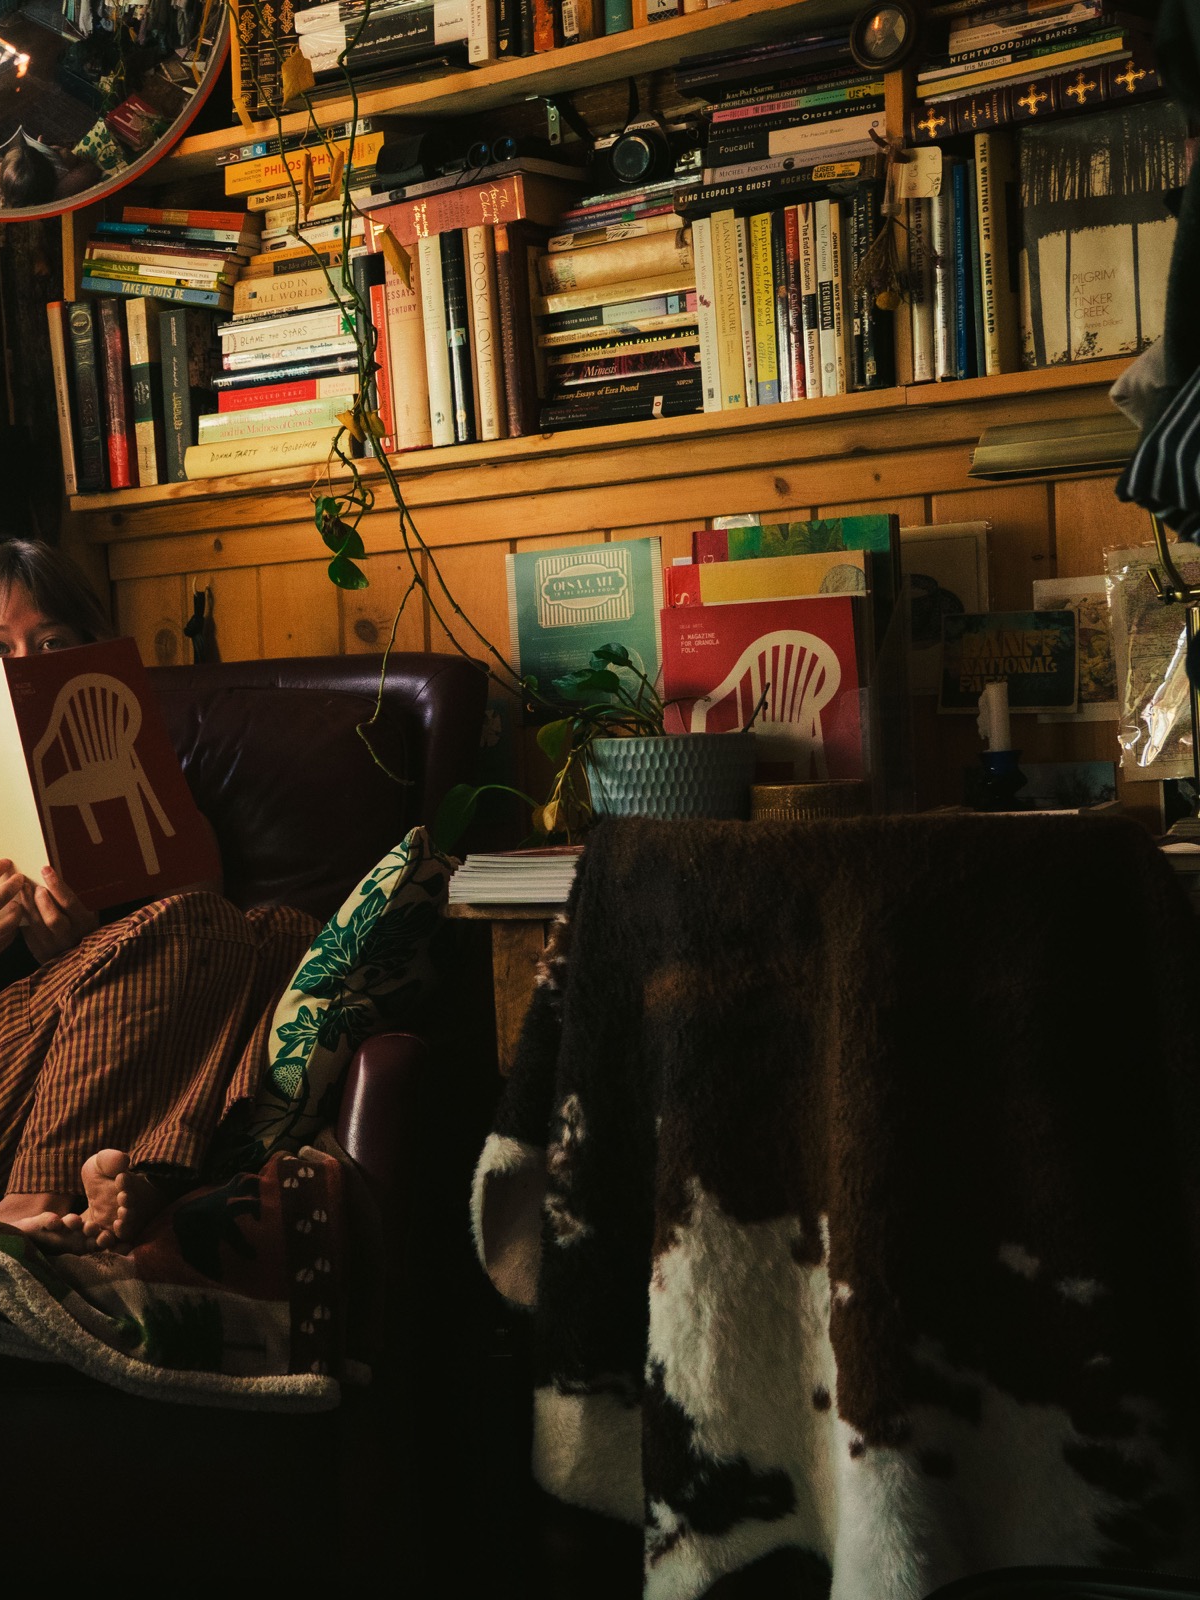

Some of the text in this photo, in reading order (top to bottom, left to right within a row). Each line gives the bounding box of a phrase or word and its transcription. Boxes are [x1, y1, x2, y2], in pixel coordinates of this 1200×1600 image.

[949, 25, 1078, 64] NIGHTWOOD DJUNA BARNES
[977, 56, 1007, 69] Murdoch
[721, 99, 756, 109] PROBLEMS
[766, 87, 808, 101] PHILOSOPHY
[817, 80, 848, 91] BERTRAND
[848, 75, 874, 86] RUSSELL
[627, 122, 657, 131] PENTAX
[712, 102, 877, 136] MICHEL ORDER THINGS
[718, 141, 755, 154] Foucault
[718, 161, 782, 178] MICHEL FOUCAULT
[255, 192, 288, 205] The Sun Also
[678, 180, 772, 203] KING LEOPOLD'S GHOST
[751, 229, 760, 261] Language
[979, 142, 995, 334] THE WRITING LIFE ANNIE DILLARD
[820, 223, 829, 272] Neil Postman
[424, 244, 435, 312] Alberto Manguel
[722, 221, 737, 332] LANGUAGES OF NATURE
[759, 217, 774, 326] Empires of the Word
[788, 226, 800, 333] Disappearance Childhood
[1072, 268, 1116, 285] PILGRIM
[121, 281, 153, 295] TAKE ME
[272, 278, 309, 291] GOD IN
[1073, 284, 1086, 296] AT
[256, 286, 323, 304] ALL WORLDS
[387, 287, 416, 301] ESSAYS
[802, 223, 817, 374] The End Education Neil Postman
[1073, 292, 1113, 308] TINKER
[739, 257, 745, 269] BY
[744, 330, 752, 369] DILLARD
[822, 280, 833, 331] TECHNOPOLY
[835, 302, 841, 312] OF
[1073, 304, 1110, 320] CREEK
[240, 333, 265, 347] BLAME
[473, 252, 493, 416] BOOK LOVE DAVIDSON
[636, 329, 696, 345] FADIMAN FSG
[507, 329, 515, 363] BORGES
[584, 364, 619, 378] Mimesis
[217, 380, 234, 388] DAY
[576, 382, 640, 399] Essays Ezra Pound
[243, 388, 304, 404] TANGLED TREE
[246, 421, 278, 434] Madness
[687, 632, 716, 640] MAGAZINE
[694, 639, 720, 647] GRANOLA
[961, 628, 1061, 657] BANFF
[960, 655, 1059, 675] NATIONAL
